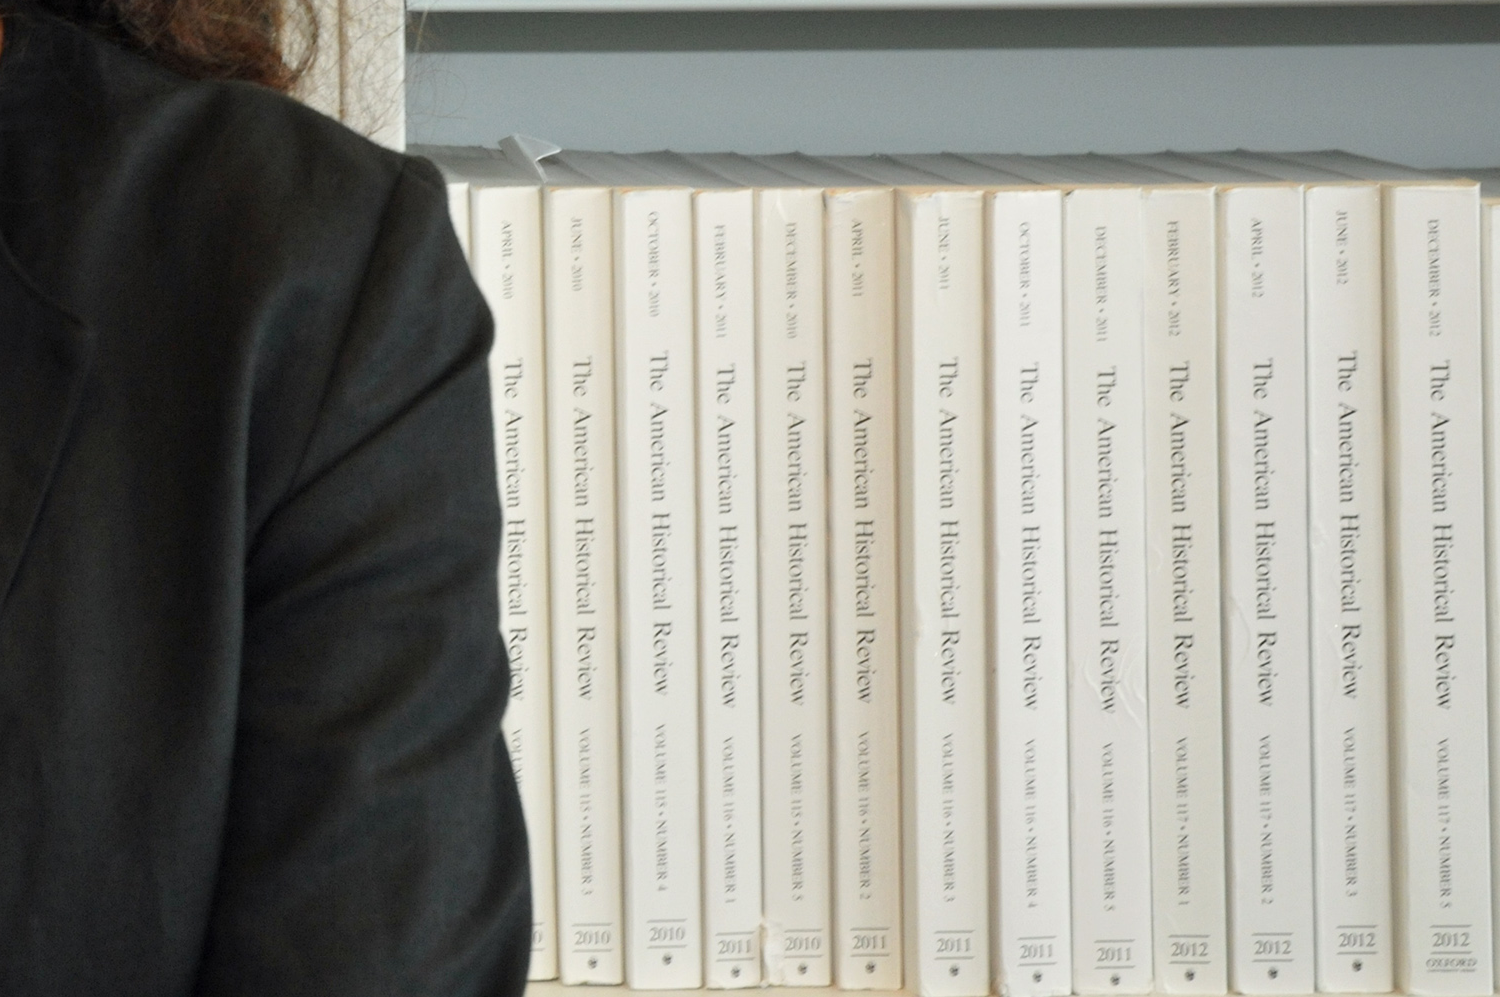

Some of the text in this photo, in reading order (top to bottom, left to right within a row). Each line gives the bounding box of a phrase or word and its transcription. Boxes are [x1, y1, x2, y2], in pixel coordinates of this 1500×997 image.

[851, 220, 864, 261] APRIL
[1166, 220, 1181, 299] FEBRUARY
[1427, 219, 1442, 300] DECEMBER
[852, 358, 877, 703] The American Historical Review
[1168, 360, 1196, 709] The American Historical Review
[1429, 359, 1457, 710] The American Historical Review
[857, 731, 872, 793] VOLUME
[1175, 737, 1191, 799] VOLUME
[1436, 738, 1452, 801] VOLUME
[857, 827, 872, 889] NUMBER
[1175, 834, 1191, 896] NUMBER
[1436, 835, 1452, 897] NUMBER
[852, 935, 886, 950] 2011
[1171, 941, 1209, 957] 2012
[1432, 933, 1470, 947] 2012
